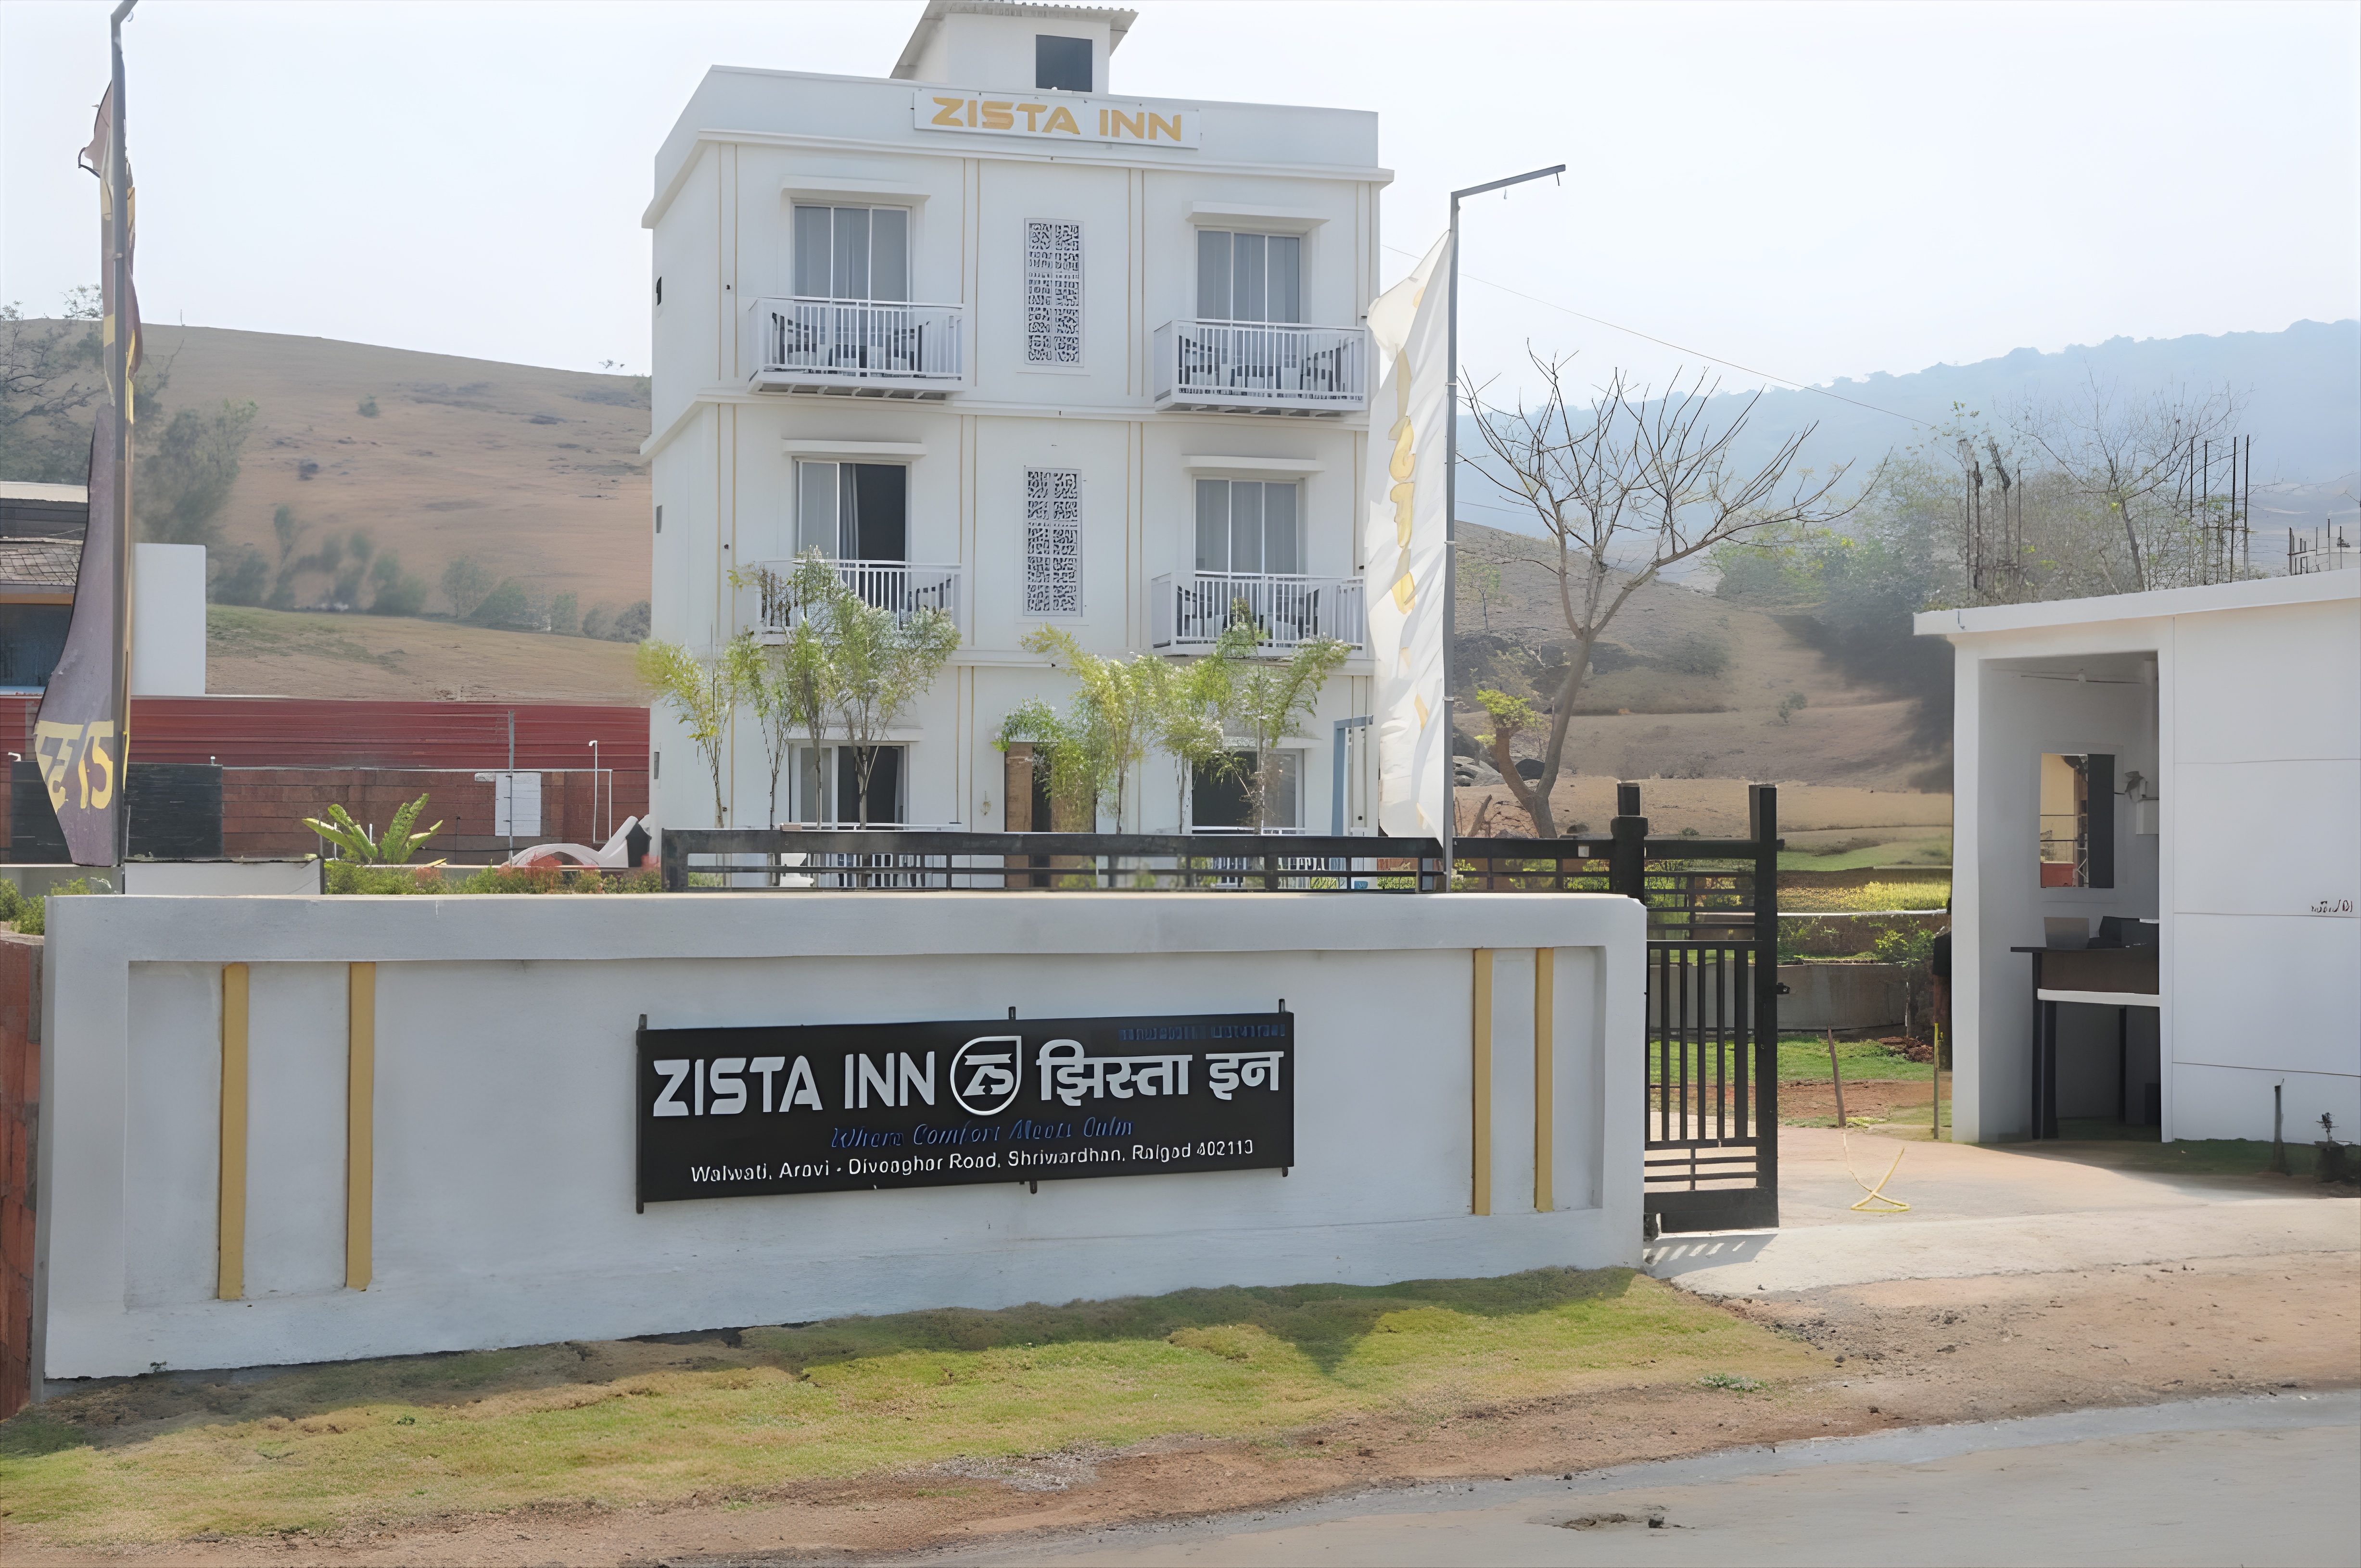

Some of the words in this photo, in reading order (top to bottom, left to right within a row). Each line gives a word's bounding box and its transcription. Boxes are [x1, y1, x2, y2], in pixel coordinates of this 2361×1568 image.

[931, 97, 1080, 135] ZISTA
[1100, 109, 1181, 141] INN
[653, 1055, 823, 1117] ZISTA
[845, 1051, 935, 1109] INN
[1036, 1039, 1193, 1106] झिस्ता
[1206, 1051, 1284, 1100] इन
